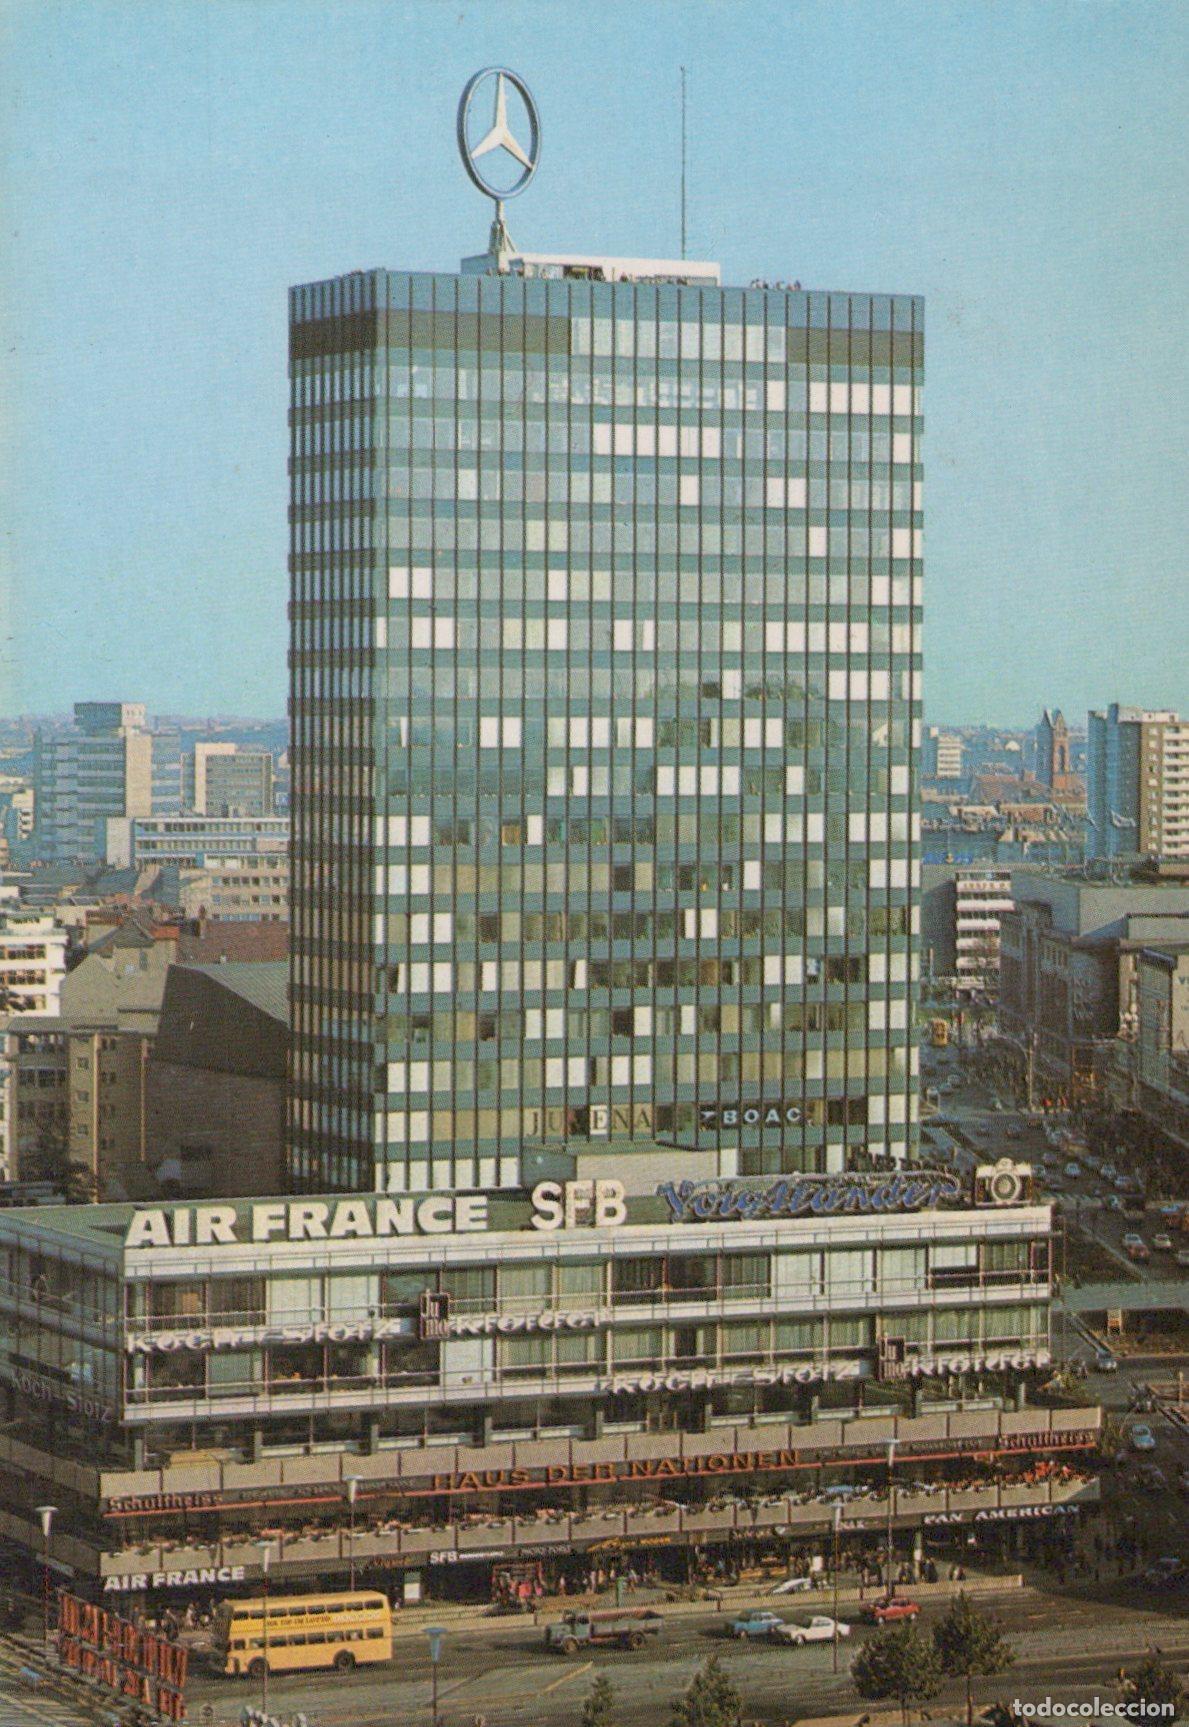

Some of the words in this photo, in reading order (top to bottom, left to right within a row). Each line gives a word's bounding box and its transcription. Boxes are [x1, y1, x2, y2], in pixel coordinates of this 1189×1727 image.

[525, 1105, 652, 1136] JUENA
[723, 1106, 802, 1125] BOAC
[530, 1179, 628, 1231] SFB
[125, 1206, 239, 1248] AIR
[250, 1195, 489, 1242] FRANCE
[433, 1468, 530, 1491] HAUS
[547, 1463, 616, 1483] DER
[630, 1449, 801, 1477] NATIONEN
[923, 1512, 964, 1525] PAN
[974, 1504, 1081, 1521] AMERICAN
[429, 1550, 459, 1565] SFB
[103, 1574, 148, 1591] AIR
[151, 1566, 246, 1588] FRANCE
